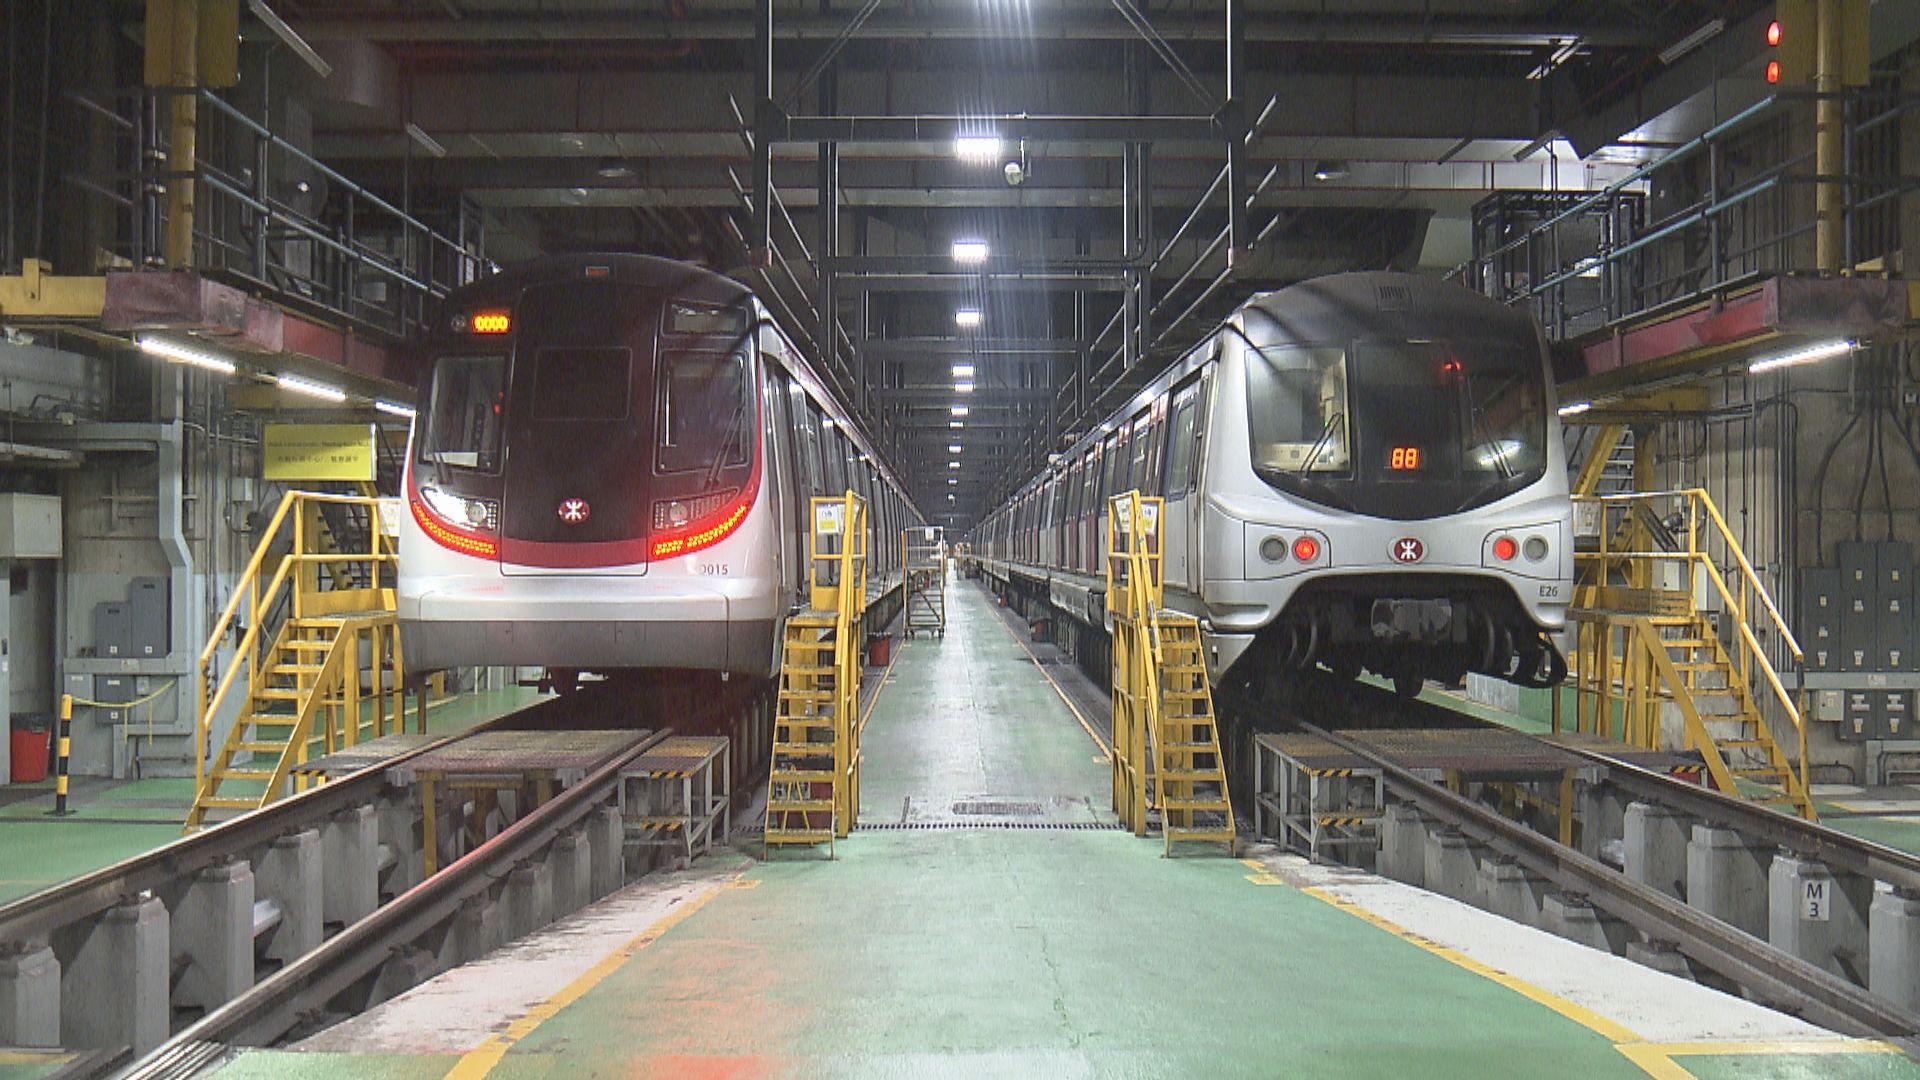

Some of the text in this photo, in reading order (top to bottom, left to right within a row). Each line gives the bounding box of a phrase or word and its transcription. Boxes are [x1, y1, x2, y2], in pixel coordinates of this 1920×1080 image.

[1391, 447, 1418, 469] 88
[1539, 585, 1558, 597] E26
[1806, 883, 1823, 899] M
[1809, 902, 1819, 918] 3
